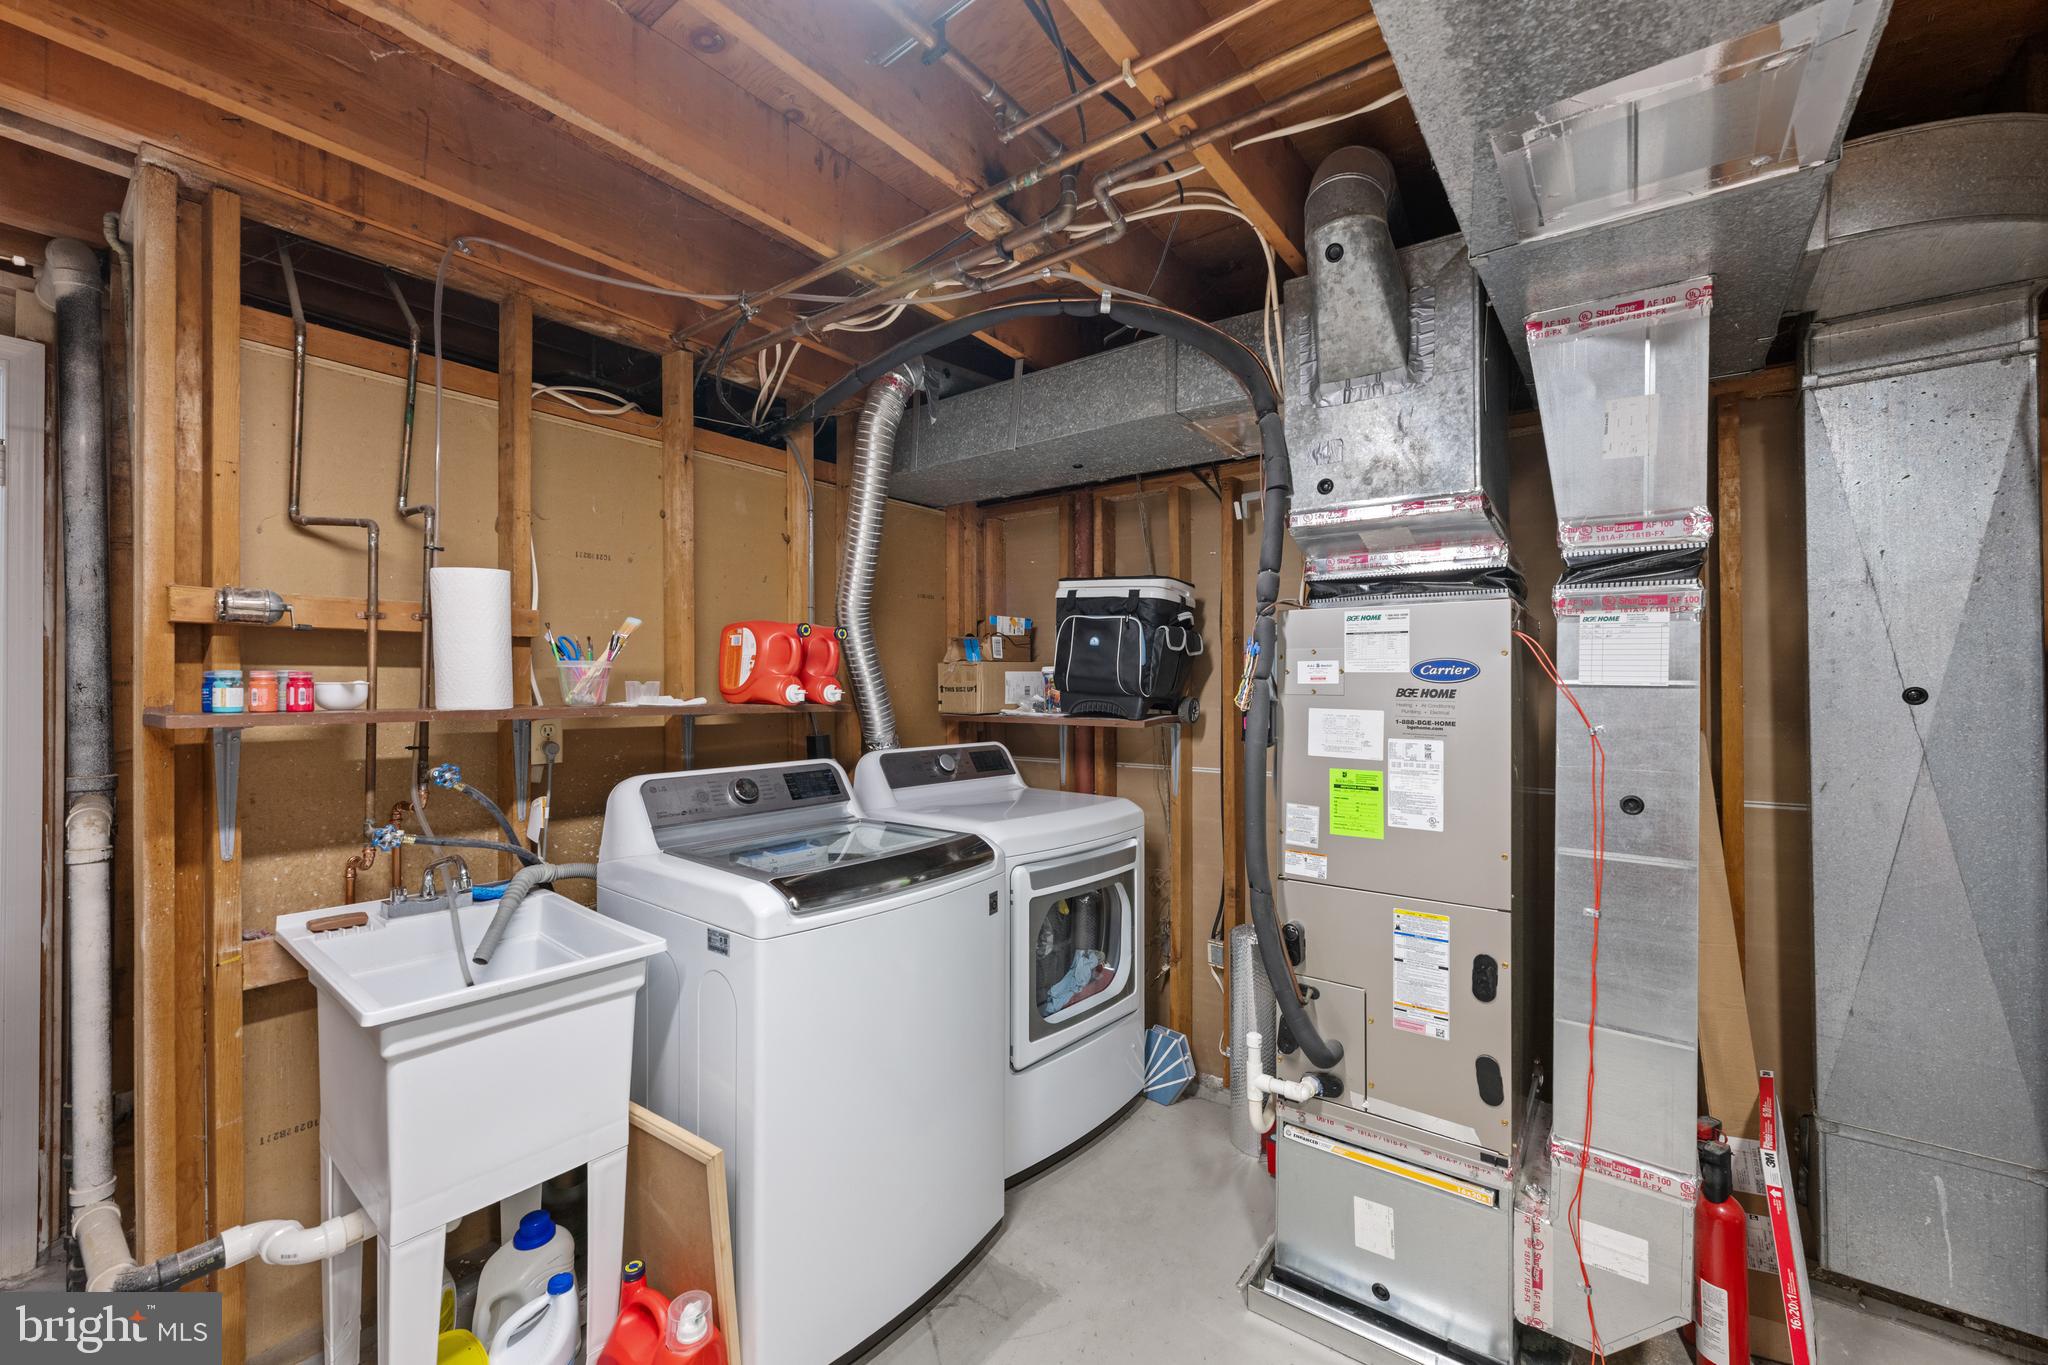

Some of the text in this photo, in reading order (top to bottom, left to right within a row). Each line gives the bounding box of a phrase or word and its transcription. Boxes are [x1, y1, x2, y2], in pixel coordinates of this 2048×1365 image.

[1595, 304, 1635, 318] Shurtape
[1647, 300, 1658, 308] AF
[1661, 295, 1677, 305] 100
[1557, 317, 1571, 326] 100
[1595, 522, 1635, 533] Shurtape
[1645, 521, 1657, 529] AF
[1660, 519, 1675, 527] 100
[1597, 534, 1624, 543] 181A-P
[1671, 596, 1682, 604] AF
[1685, 595, 1699, 604] 100
[1420, 664, 1471, 676] Carrier
[1396, 688, 1457, 699] BGE HOME
[1766, 1152, 1776, 1169] 3M
[1593, 1156, 1672, 1187] Shurtape AF 100
[1533, 1300, 1541, 1312] 100
[1786, 1293, 1802, 1330] 16x20x1
